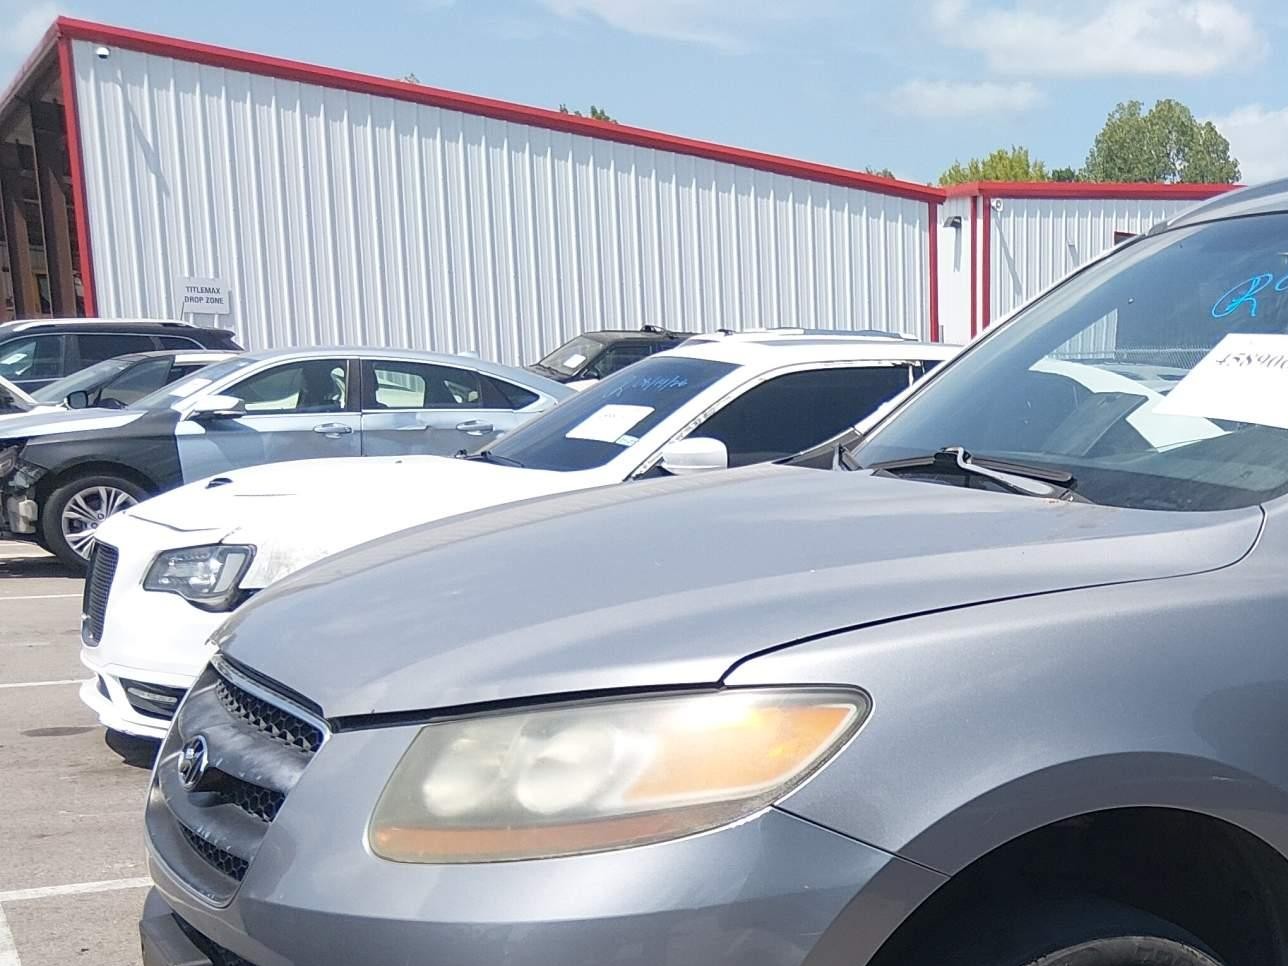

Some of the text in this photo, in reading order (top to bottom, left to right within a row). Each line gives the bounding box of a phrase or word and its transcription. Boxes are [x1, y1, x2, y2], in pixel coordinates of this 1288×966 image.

[185, 285, 221, 295] TITLEMAX
[184, 295, 225, 305] DROP ZONE
